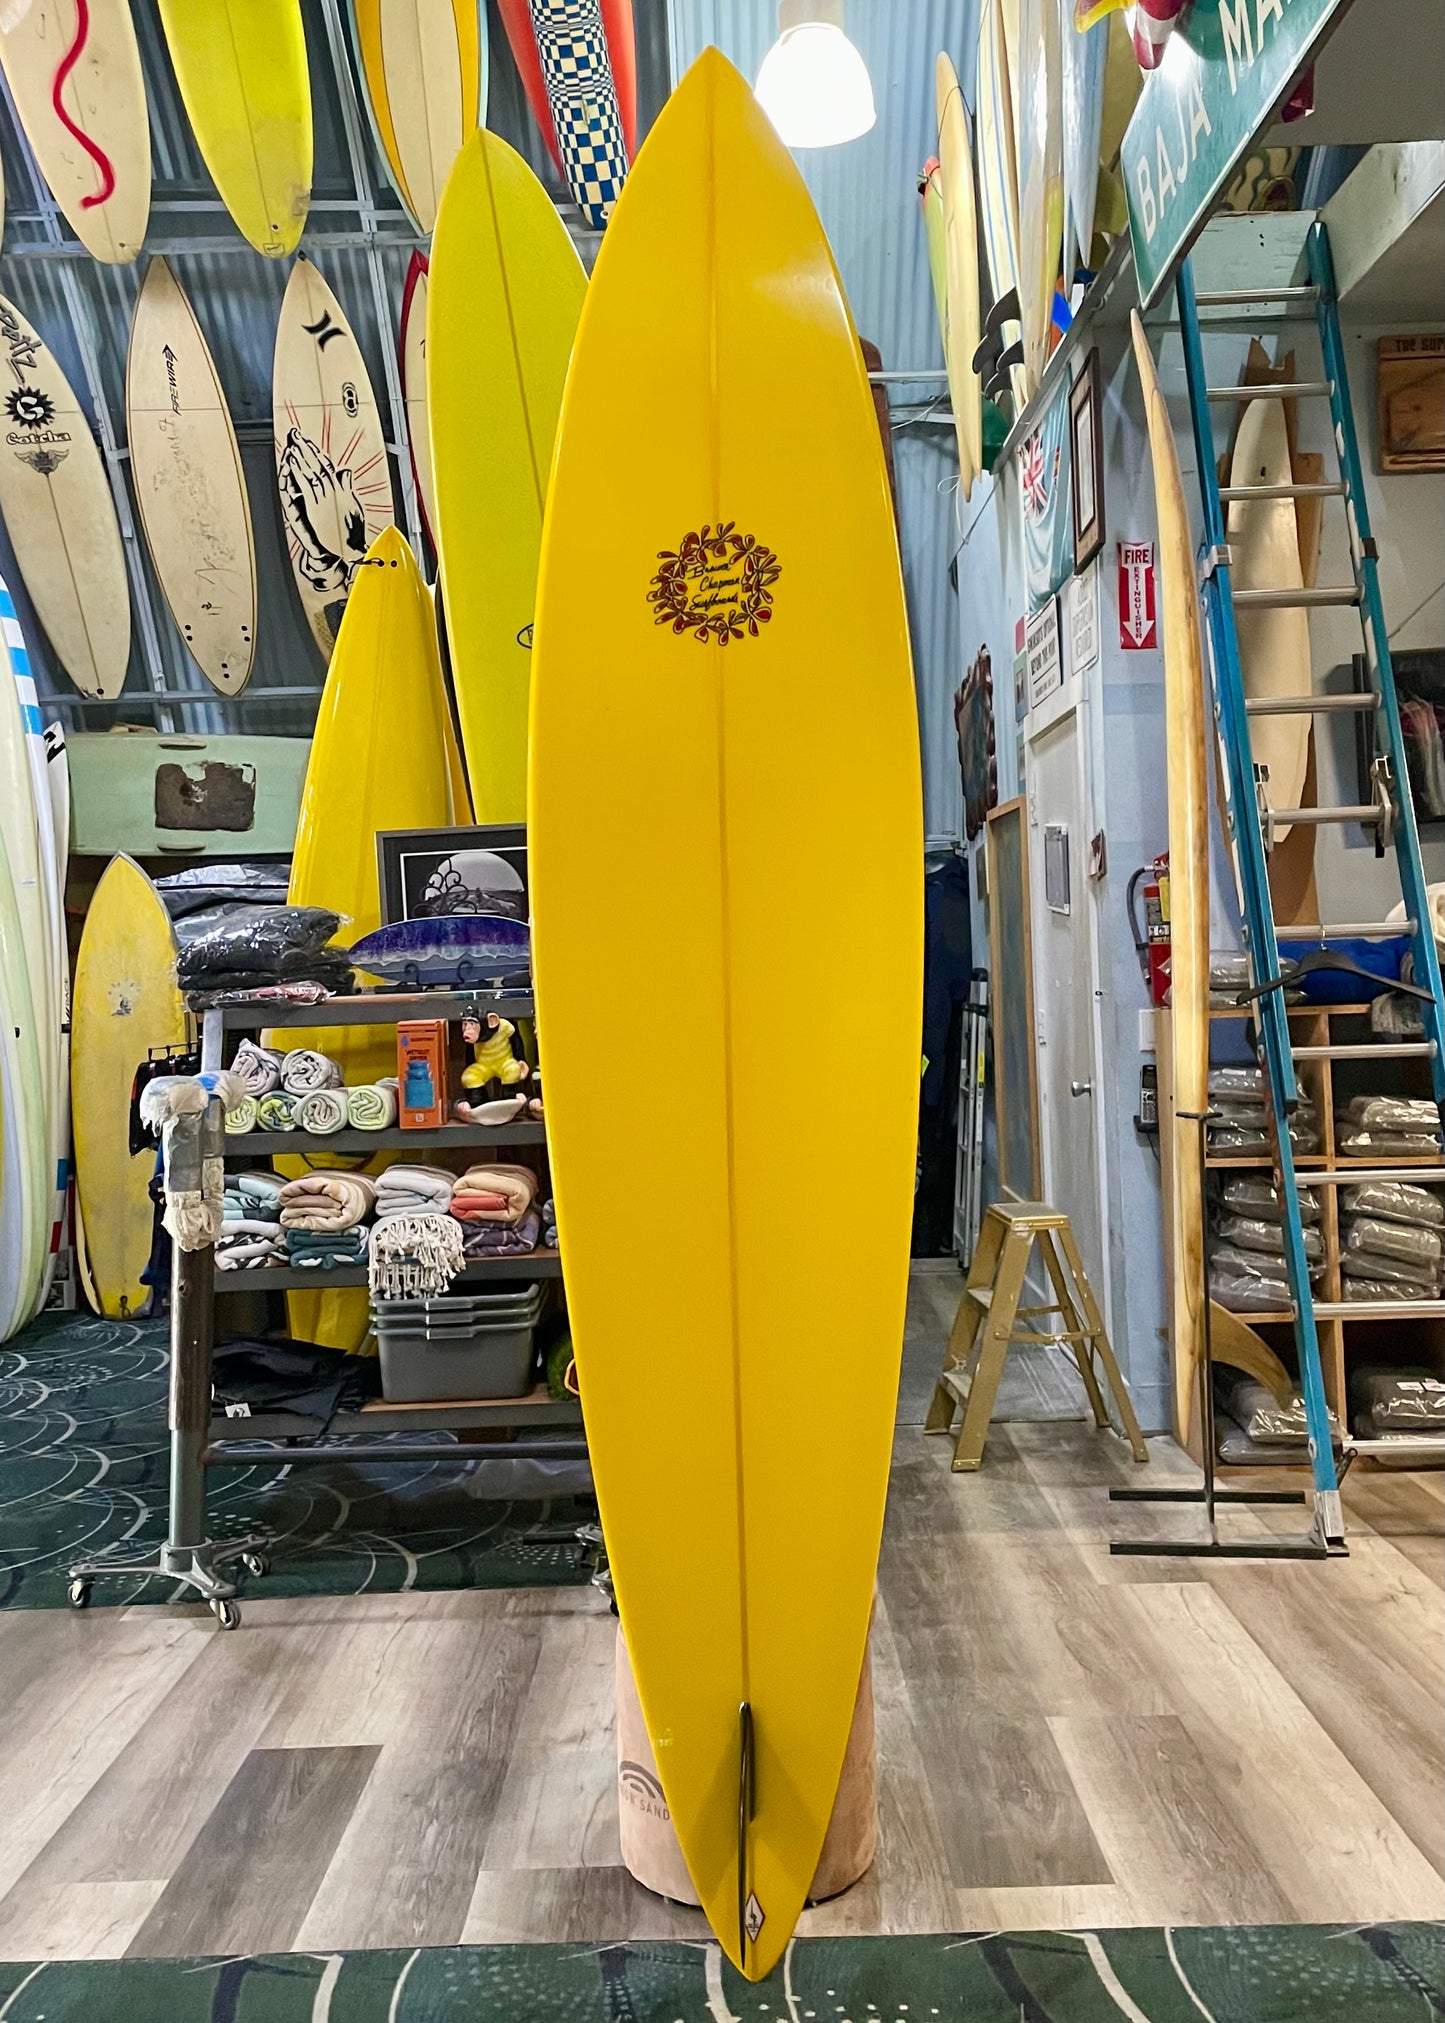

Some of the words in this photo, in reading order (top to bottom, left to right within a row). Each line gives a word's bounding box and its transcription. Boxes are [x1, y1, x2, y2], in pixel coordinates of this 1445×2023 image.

[1136, 80, 1212, 244] BAJA
[1218, 0, 1291, 95] MA
[1124, 549, 1150, 564] FIRE
[1133, 566, 1143, 640] EXTINGUISHER
